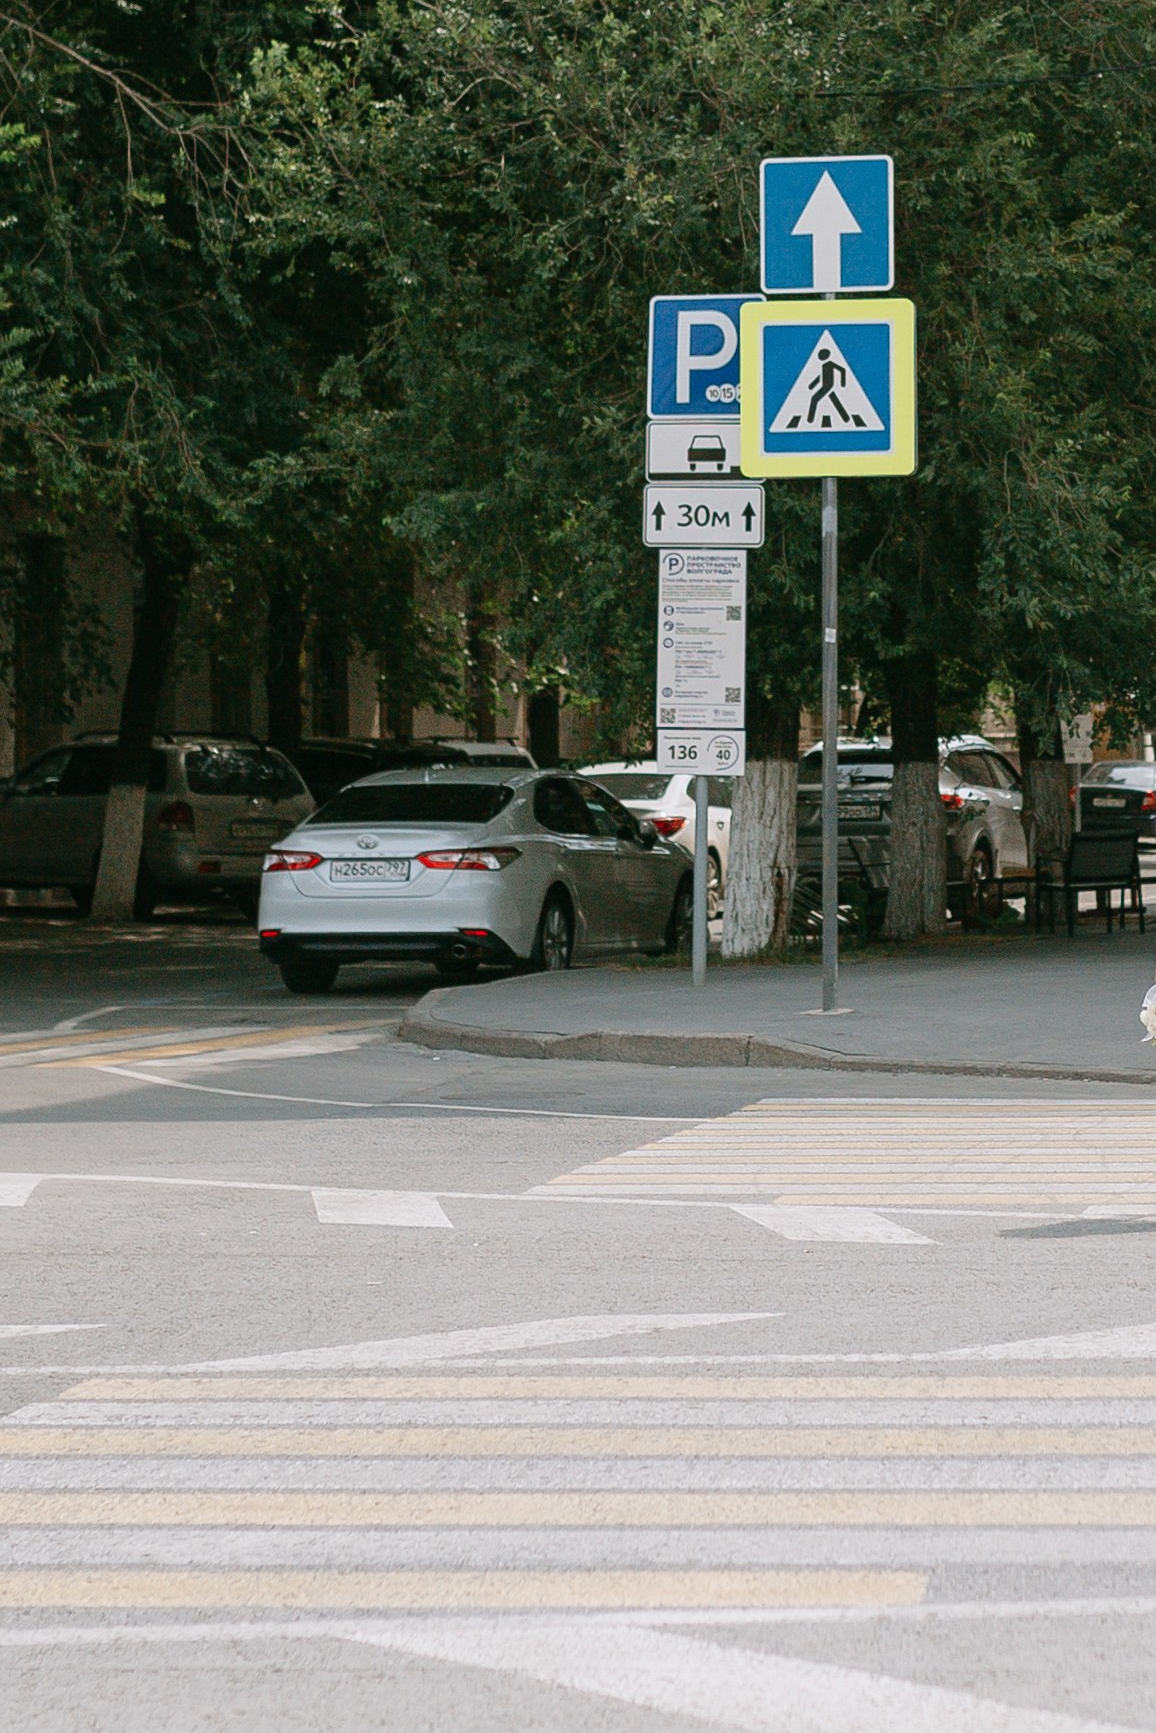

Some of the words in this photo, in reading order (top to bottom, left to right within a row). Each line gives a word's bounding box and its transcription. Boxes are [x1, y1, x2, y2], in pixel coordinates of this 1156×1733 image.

[676, 310, 738, 404] P
[722, 387, 734, 399] 15
[668, 745, 698, 760] 136
[716, 749, 731, 761] 40
